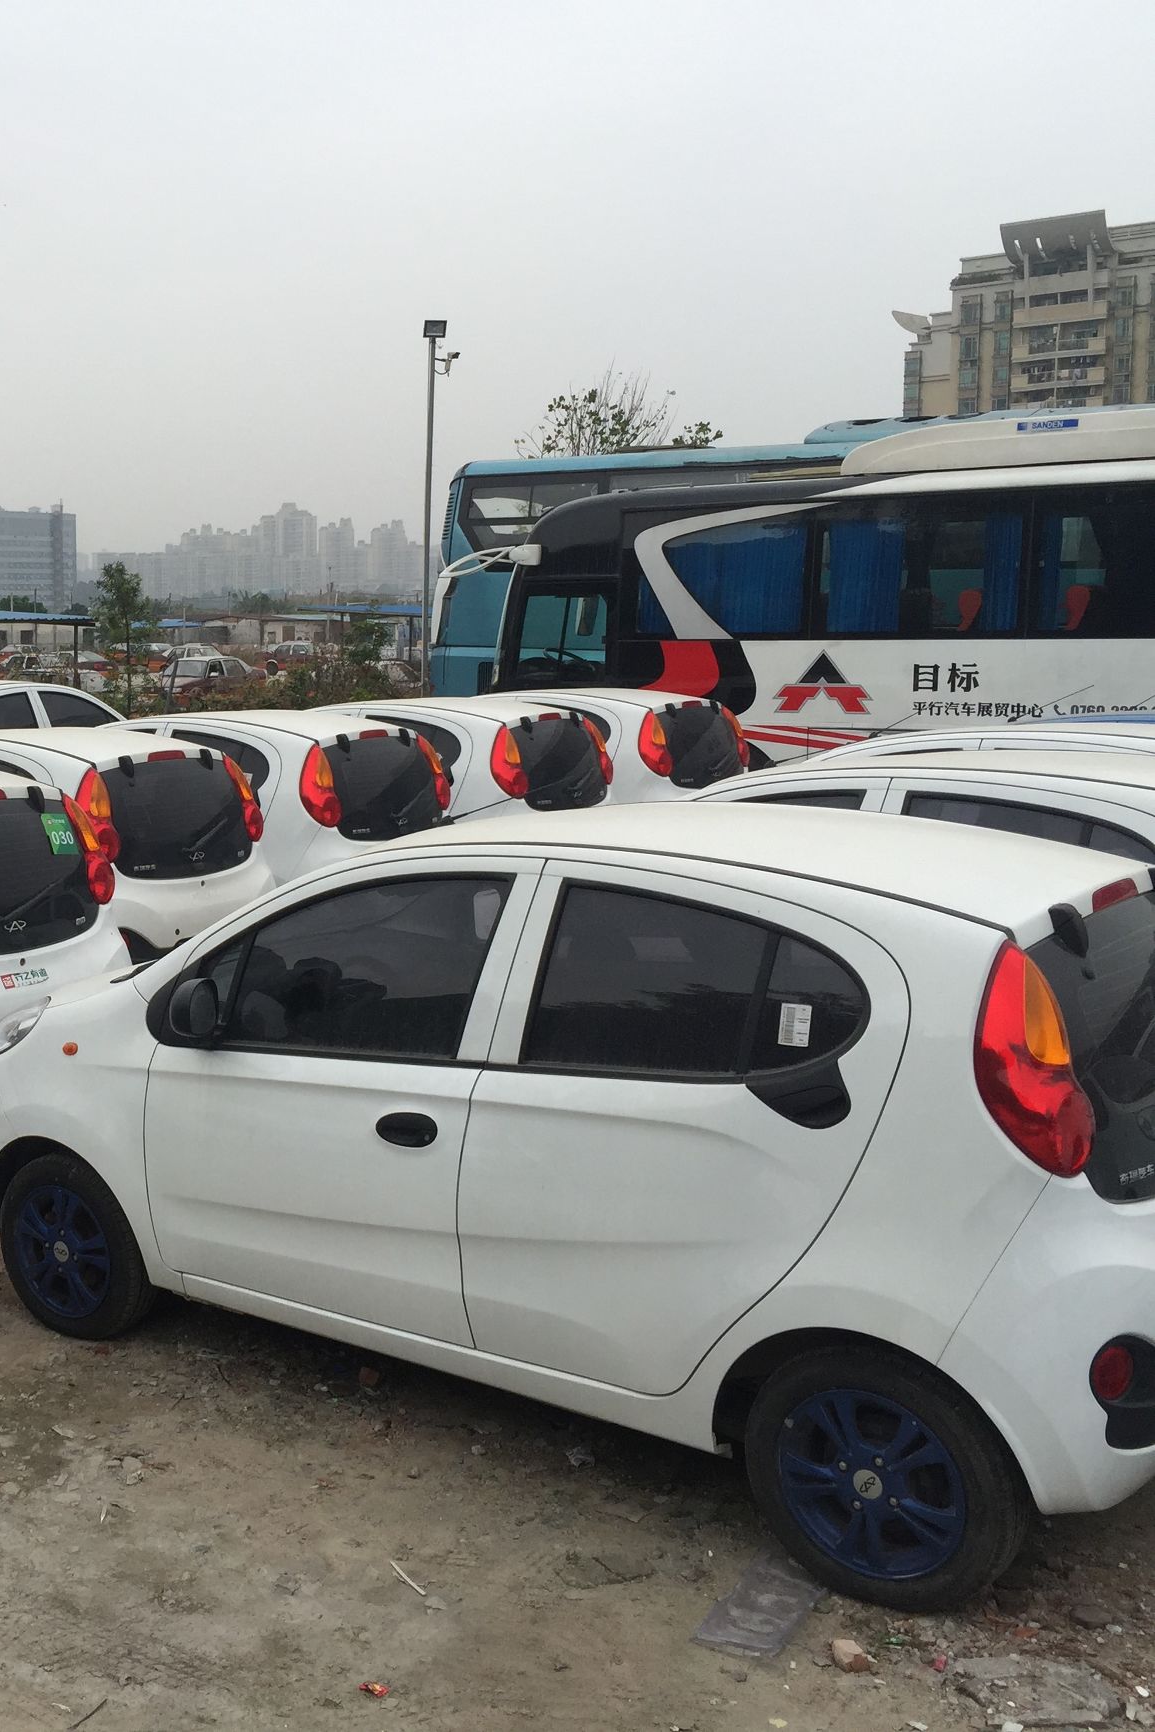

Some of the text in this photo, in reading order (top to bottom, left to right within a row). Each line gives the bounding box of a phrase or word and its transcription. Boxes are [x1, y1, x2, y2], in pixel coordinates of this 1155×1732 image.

[1031, 420, 1065, 430] SANDEN
[912, 663, 980, 693] 目标
[913, 701, 1044, 718] 平行汽车展贸中心
[51, 830, 75, 845] 030
